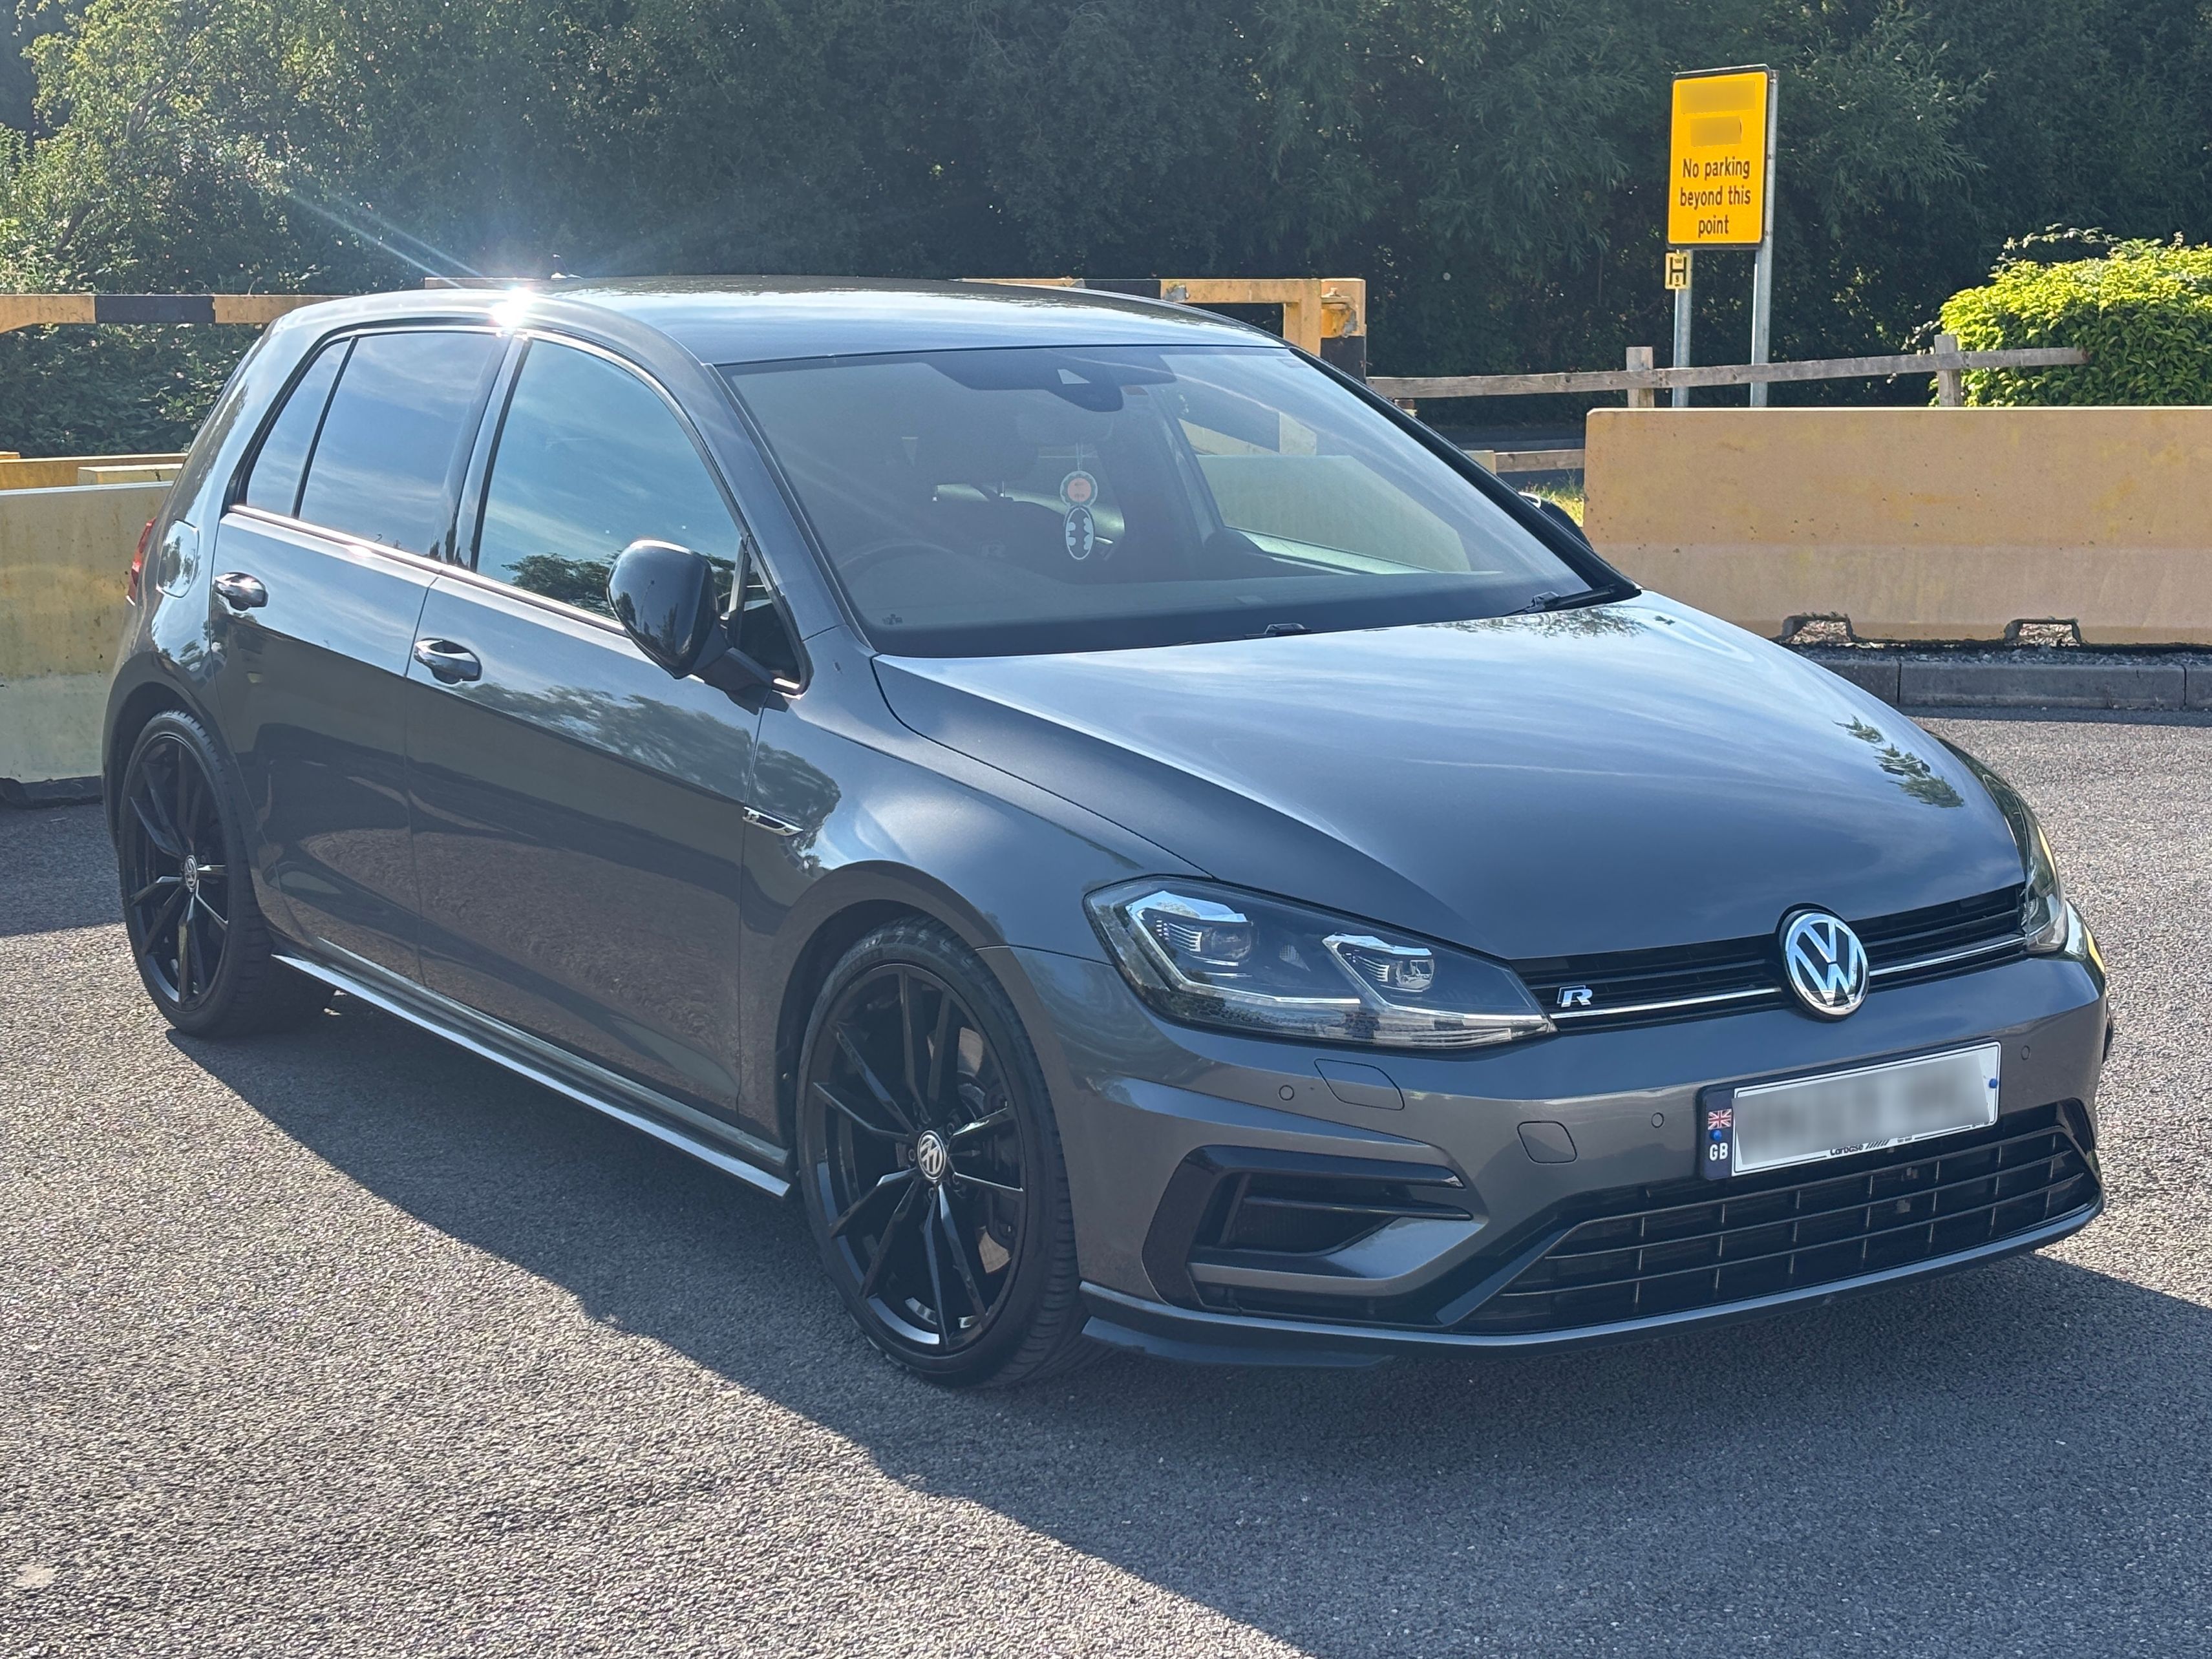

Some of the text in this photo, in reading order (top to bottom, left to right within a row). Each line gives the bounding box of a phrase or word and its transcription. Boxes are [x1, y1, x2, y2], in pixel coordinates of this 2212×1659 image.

[1683, 156, 1750, 181] No parking
[1680, 184, 1751, 210] beyond this
[1698, 214, 1729, 238] point
[1558, 984, 1593, 1008] R
[1708, 1143, 1728, 1161] GB
